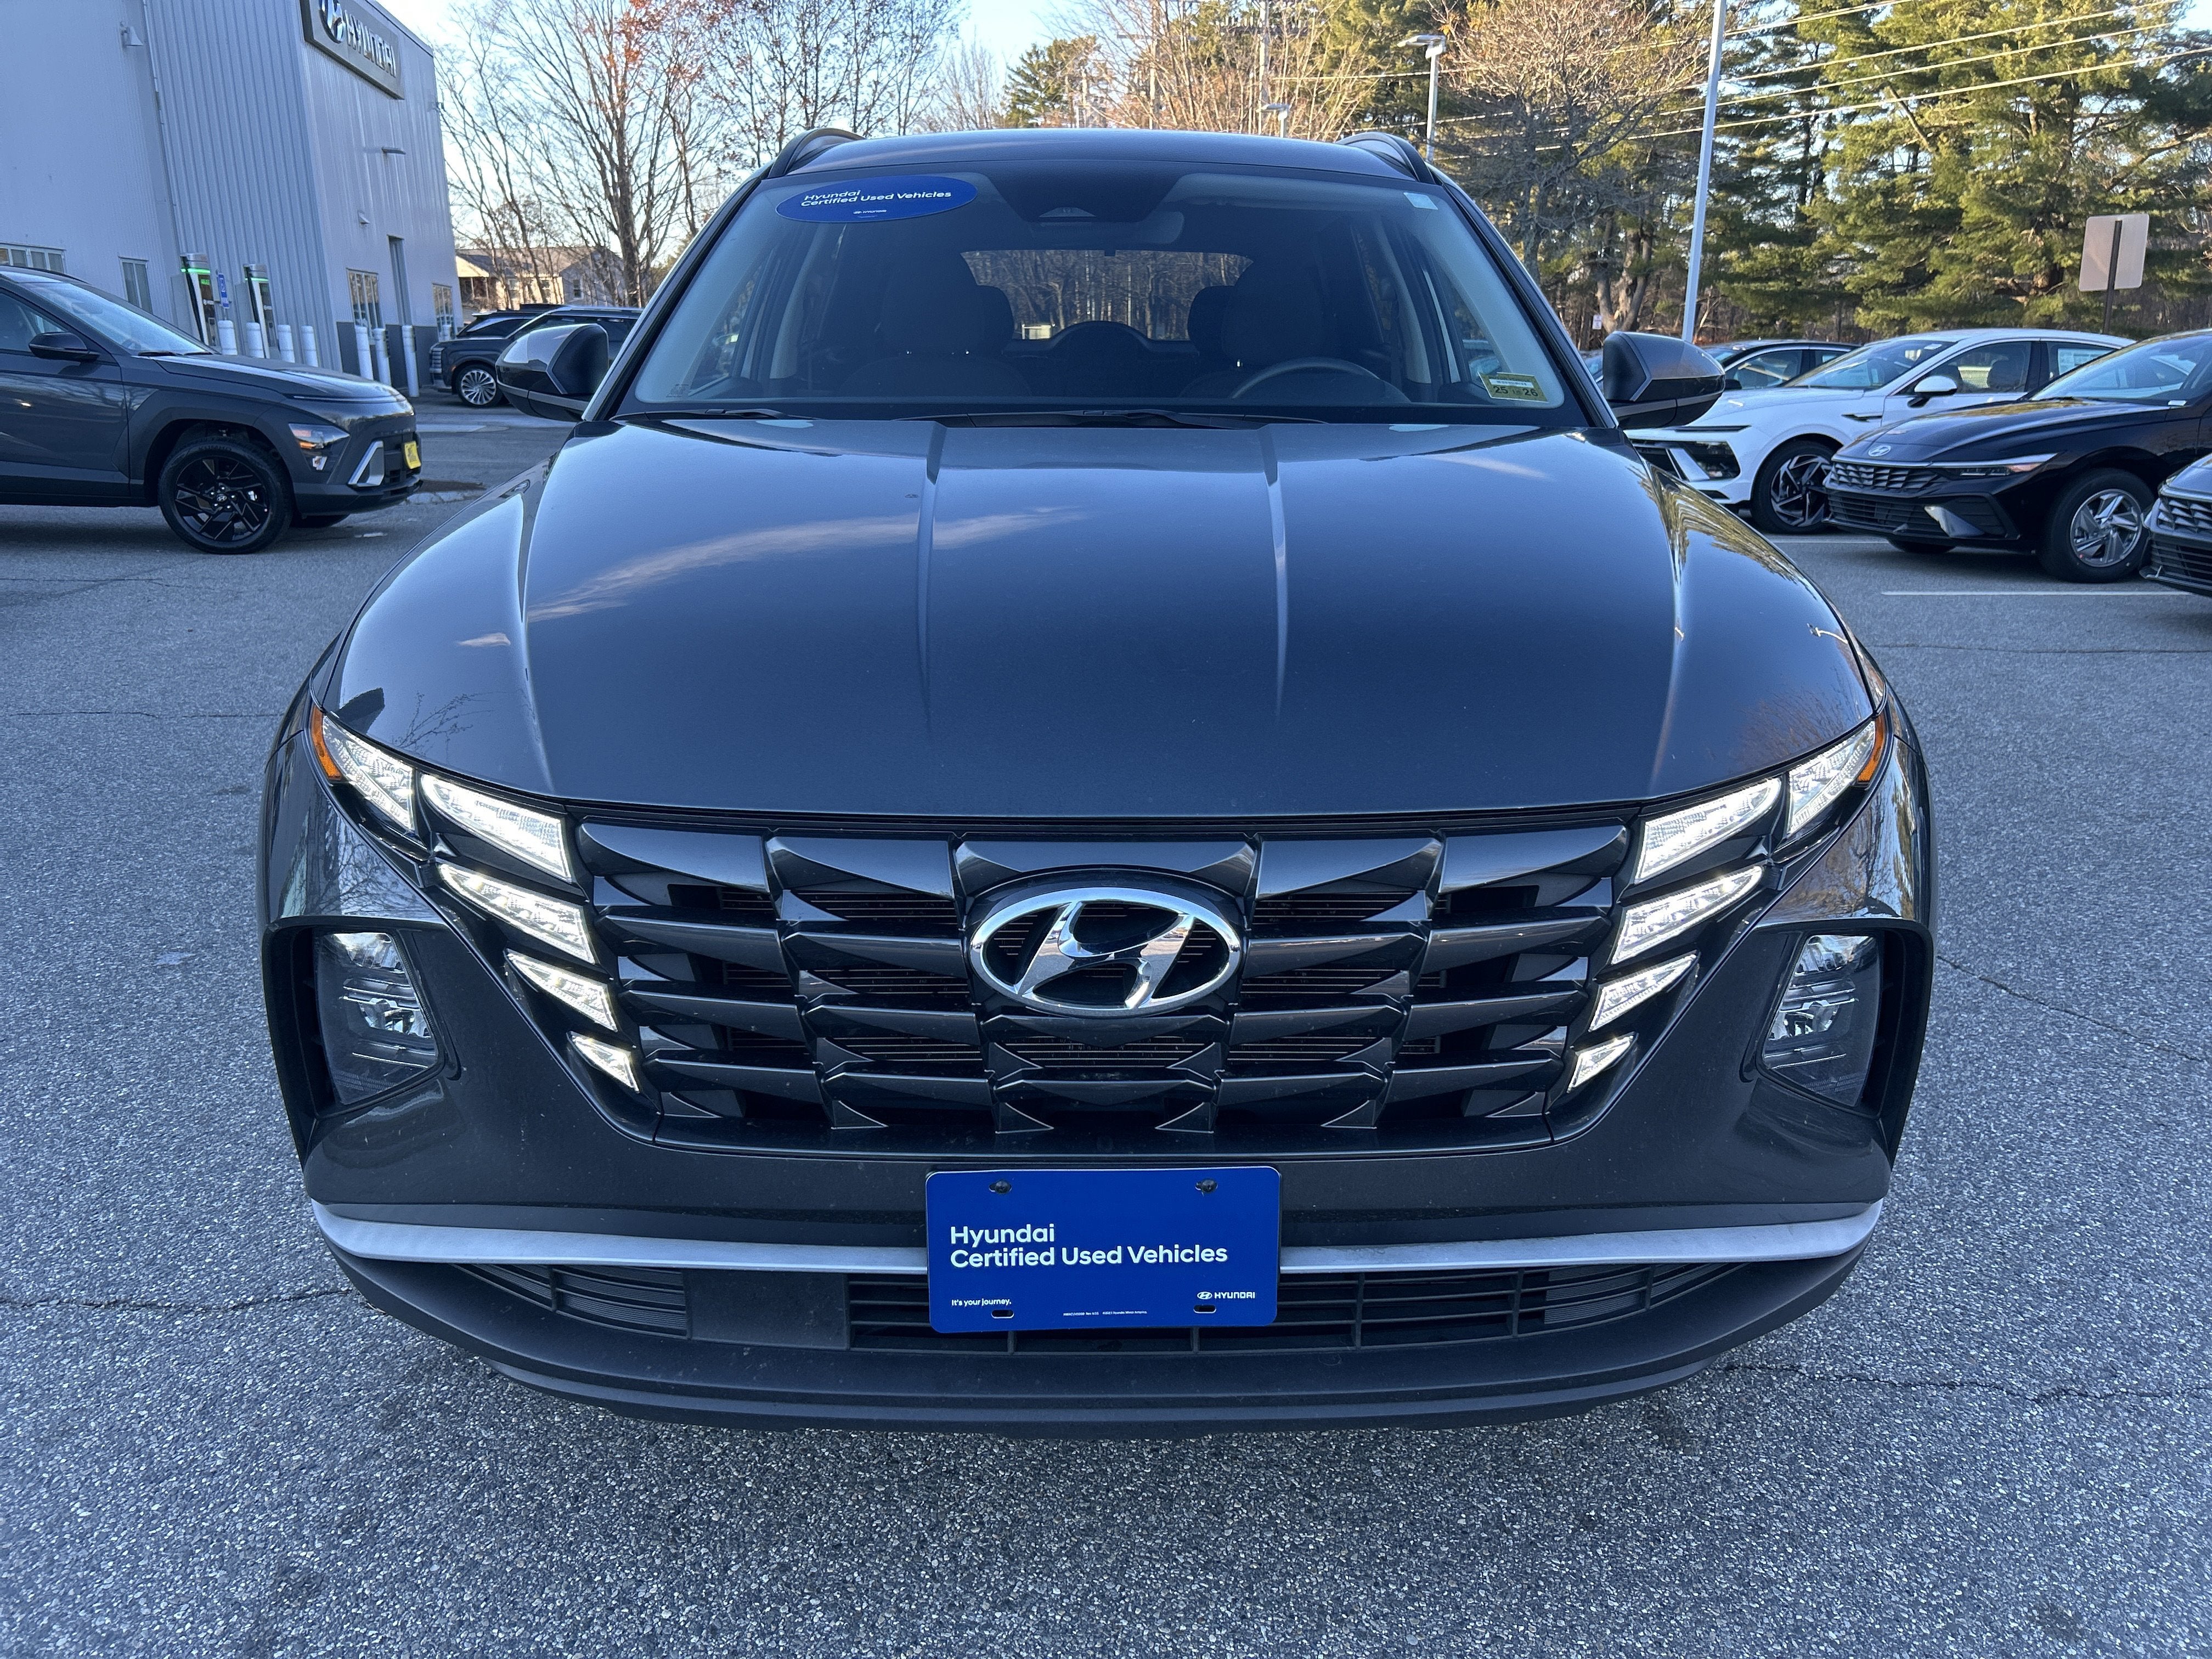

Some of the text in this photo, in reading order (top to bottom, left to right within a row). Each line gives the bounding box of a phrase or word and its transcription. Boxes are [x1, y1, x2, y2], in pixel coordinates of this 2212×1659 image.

[344, 9, 397, 78] HYUNDAI
[801, 196, 857, 206] Certified
[860, 193, 894, 201] Used
[804, 190, 861, 201] Hyundai
[1493, 386, 1508, 394] 25
[1522, 388, 1538, 396] 26
[951, 1223, 1054, 1248] Hyundai
[950, 1244, 1228, 1268] Certified Used Vehicles
[981, 1297, 1012, 1306] journey.
